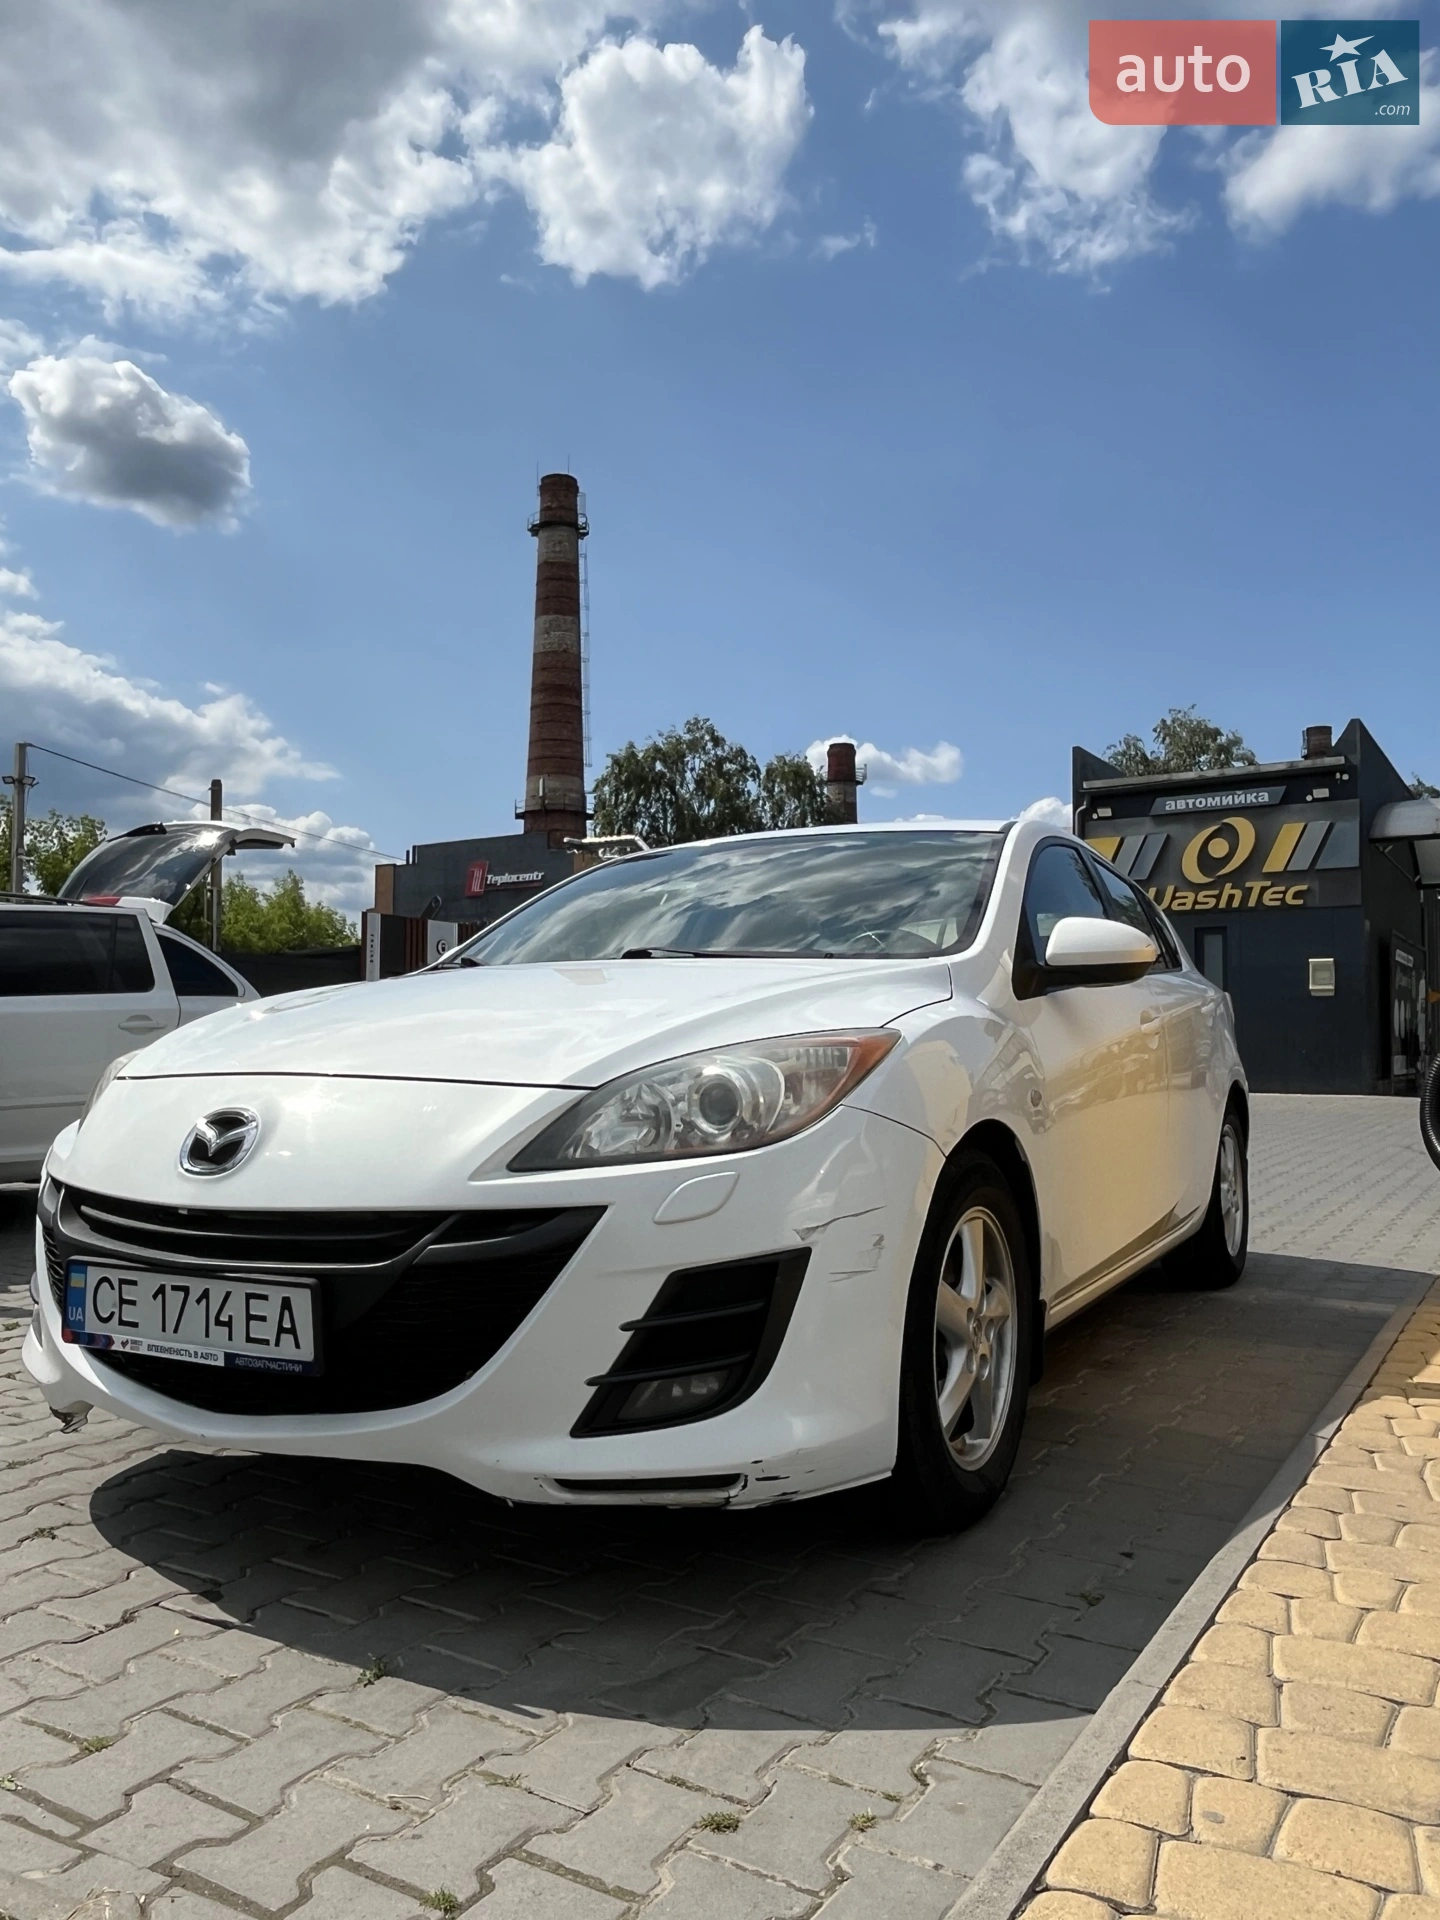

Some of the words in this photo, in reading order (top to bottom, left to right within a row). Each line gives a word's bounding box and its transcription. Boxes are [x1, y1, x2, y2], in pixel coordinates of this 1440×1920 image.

[1165, 790, 1270, 811] автомийка
[486, 871, 545, 886] Teplocentr
[68, 1306, 84, 1323] UA
[92, 1275, 140, 1329] CE
[151, 1283, 233, 1342] 1714
[244, 1291, 301, 1350] EA
